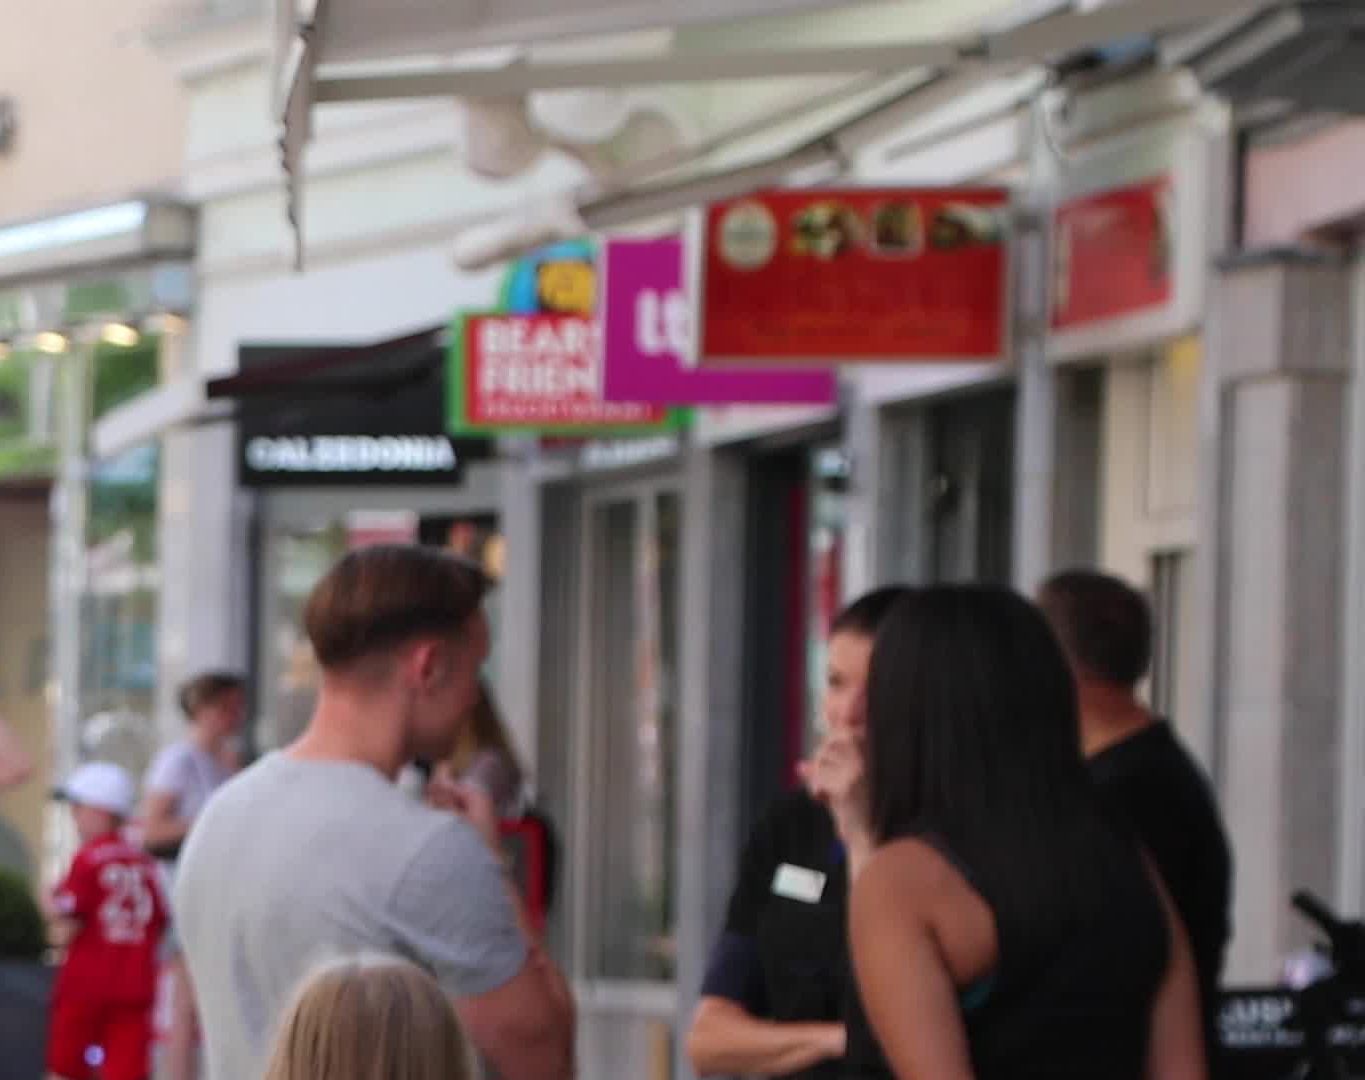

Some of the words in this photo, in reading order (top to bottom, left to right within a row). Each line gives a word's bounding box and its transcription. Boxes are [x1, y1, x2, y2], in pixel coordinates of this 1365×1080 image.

[482, 318, 599, 354] BEAR
[483, 362, 599, 396] FRIEN
[245, 433, 456, 472] CALZEDONIA
